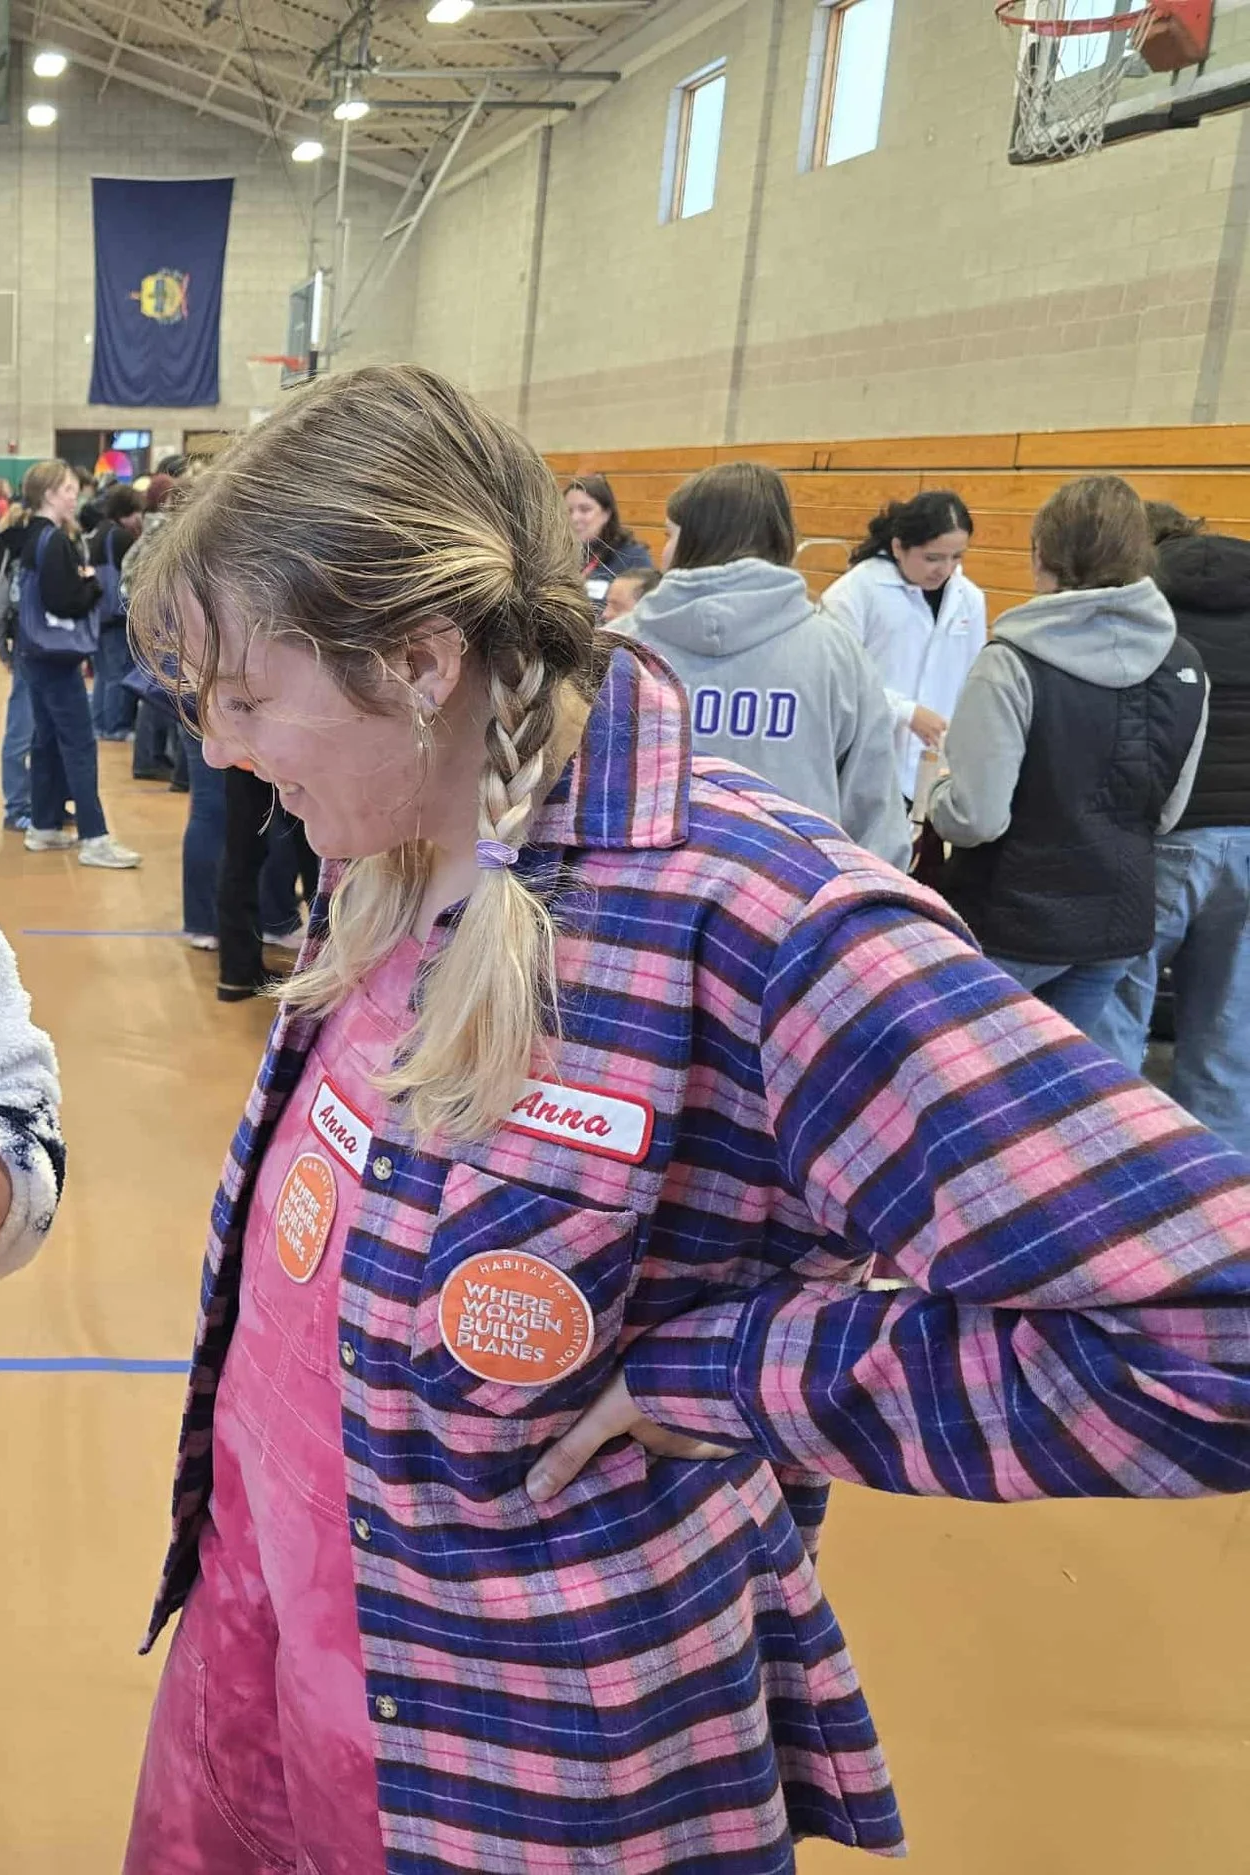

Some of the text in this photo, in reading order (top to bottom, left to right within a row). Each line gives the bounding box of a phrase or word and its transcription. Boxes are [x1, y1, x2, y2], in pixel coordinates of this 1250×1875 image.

[686, 686, 799, 740] OOD
[318, 1105, 359, 1155] Anna
[511, 1090, 612, 1137] Anna
[462, 1296, 563, 1336] WOMEN
[464, 1279, 555, 1316] WHERE
[478, 1258, 586, 1367] HABITAT for AVIATION
[457, 1331, 546, 1363] PLANES
[459, 1314, 528, 1344] BUILD
